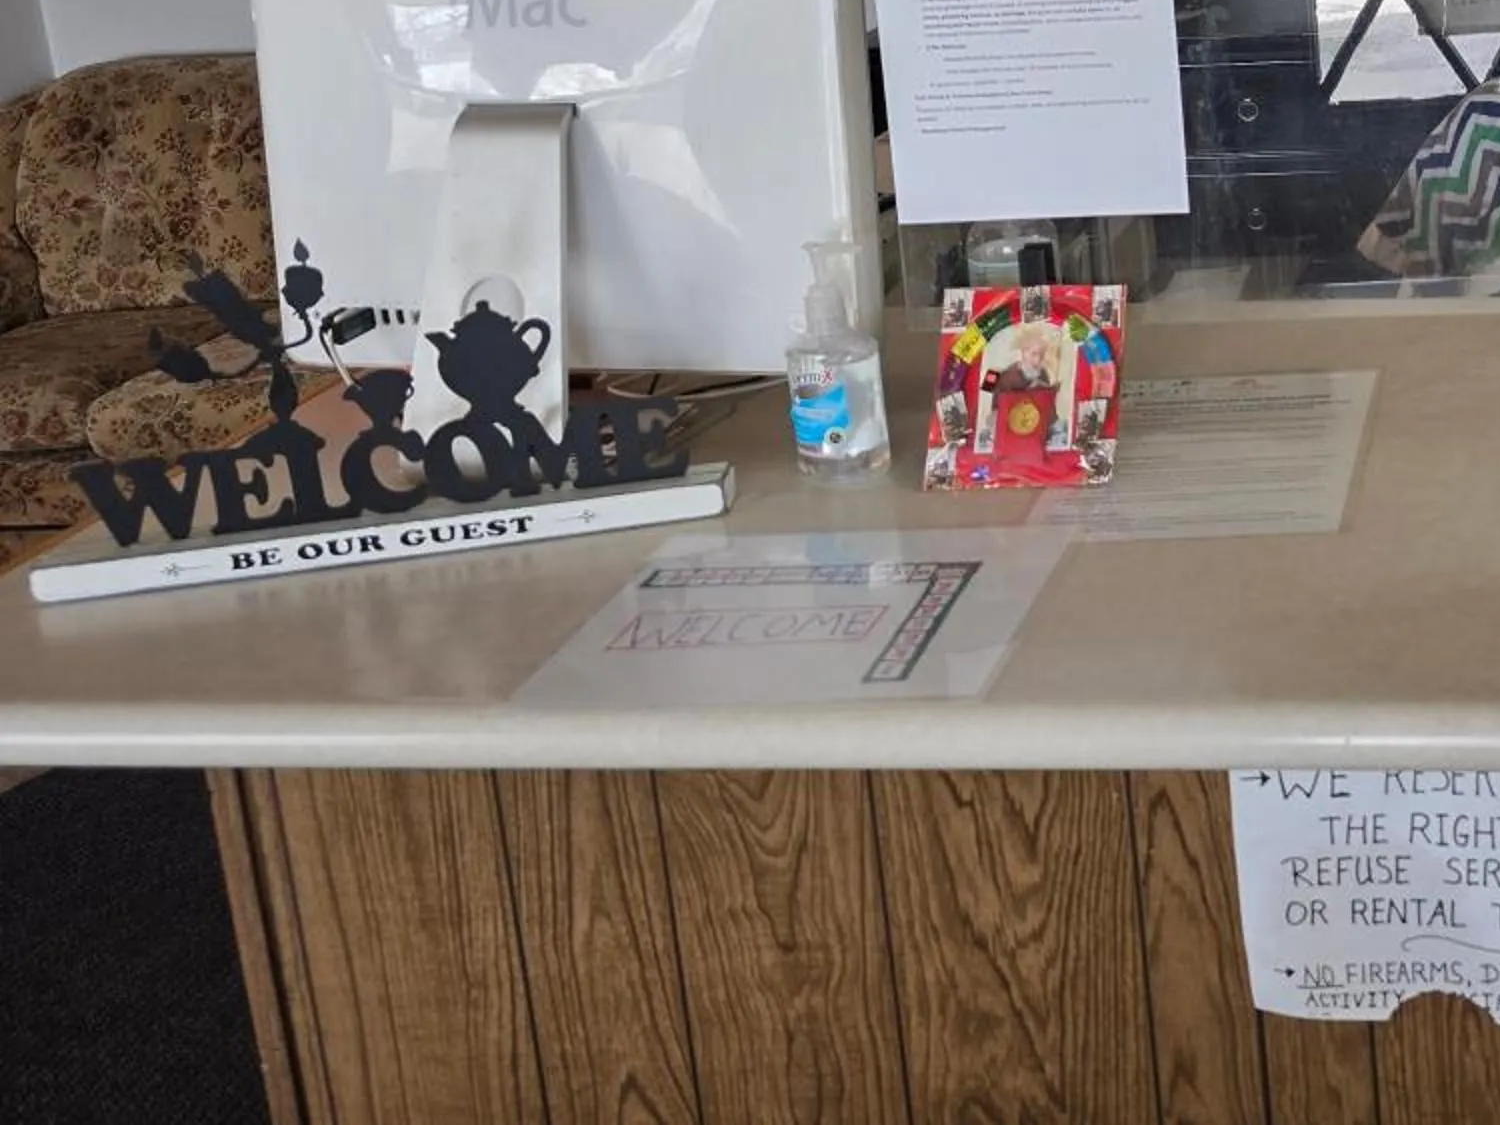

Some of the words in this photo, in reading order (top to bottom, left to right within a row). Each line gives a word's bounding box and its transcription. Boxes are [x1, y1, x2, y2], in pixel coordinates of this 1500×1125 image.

[69, 396, 691, 547] WELCOME
[229, 547, 283, 570] BE
[297, 534, 385, 560] OUR
[400, 515, 534, 546] GUEST
[629, 610, 868, 650] WELCOME
[1277, 770, 1351, 800] WE
[1319, 813, 1388, 845] THE
[1281, 855, 1413, 888] REFUSE
[1285, 898, 1329, 926] OR
[1350, 898, 1467, 930] RENTAL
[1302, 962, 1335, 987] NO
[1344, 959, 1472, 988] FIREARMS,
[1304, 989, 1406, 1010] ACTIVITY
